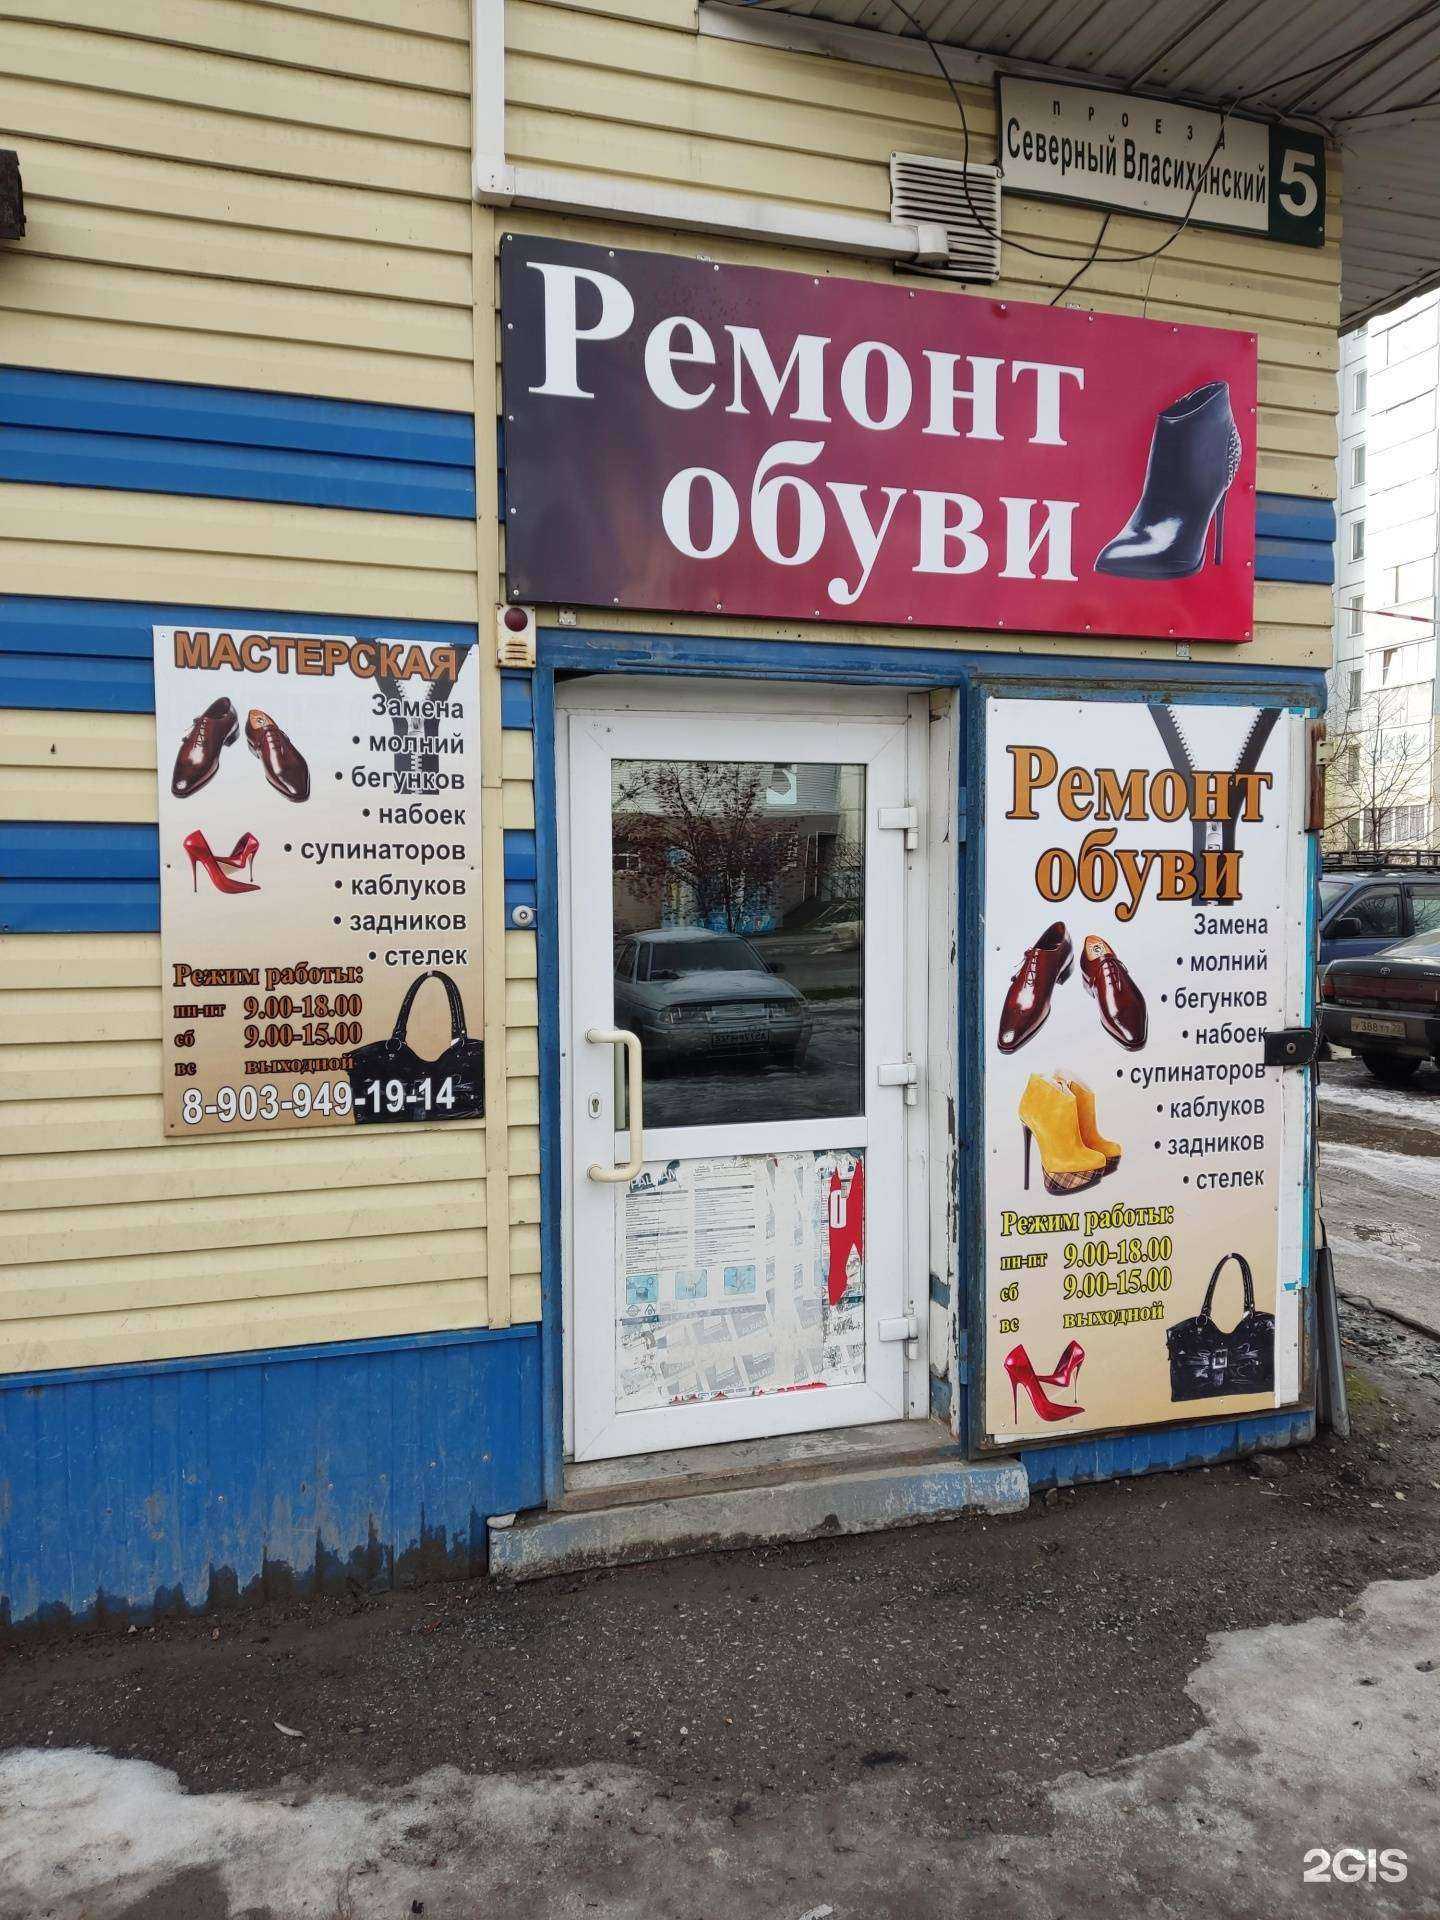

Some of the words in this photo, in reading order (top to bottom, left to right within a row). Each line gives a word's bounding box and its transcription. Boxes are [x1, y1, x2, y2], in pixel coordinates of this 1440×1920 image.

[1052, 101, 1226, 150] ПРОЕЗД
[1007, 118, 1117, 176] Северный
[1124, 138, 1267, 204] Власихинский
[1279, 149, 1319, 217] 5
[526, 262, 1085, 447] Ремонт
[661, 440, 1080, 606] обуви
[173, 630, 458, 682] МАСТЕРСКАЯ
[371, 693, 464, 720] Замена
[369, 733, 464, 755] молний
[351, 765, 465, 793] бегунков
[1006, 745, 1273, 822] Ремонт
[379, 803, 466, 826] набоек
[300, 841, 466, 866] супинаторов
[351, 875, 466, 900] каблуков
[1035, 828, 1243, 922] обуви
[350, 913, 467, 934] задников
[1194, 912, 1268, 935] Замена
[385, 947, 467, 966] стелек
[1190, 949, 1268, 972] молний
[173, 963, 259, 988] Режим
[265, 961, 364, 990] работы:
[173, 1004, 226, 1018] пн-пт
[244, 994, 363, 1020] 9.00-18.00
[1174, 987, 1268, 1013] бегунков
[174, 1029, 195, 1048] сб
[244, 1021, 363, 1048] 9.00-15.00
[1196, 1023, 1268, 1045] набоек
[174, 1062, 197, 1076] вс
[245, 1053, 355, 1075] выходной
[1130, 1062, 1266, 1089] супинаторов
[182, 1077, 455, 1124] 8-903-949-19-14
[1170, 1095, 1265, 1121] каблуков
[1167, 1134, 1265, 1157] задников
[1196, 1169, 1265, 1190] стелек
[1001, 1210, 1079, 1236] Режим
[1084, 1203, 1174, 1235] работы:
[1000, 1253, 1048, 1271] пн-пт
[1063, 1236, 1173, 1269] 9.00-18.00
[1000, 1282, 1019, 1302] сб
[1063, 1266, 1173, 1300] 9.00-15.00
[1000, 1316, 1020, 1334] вс
[1063, 1301, 1164, 1329] выходной
